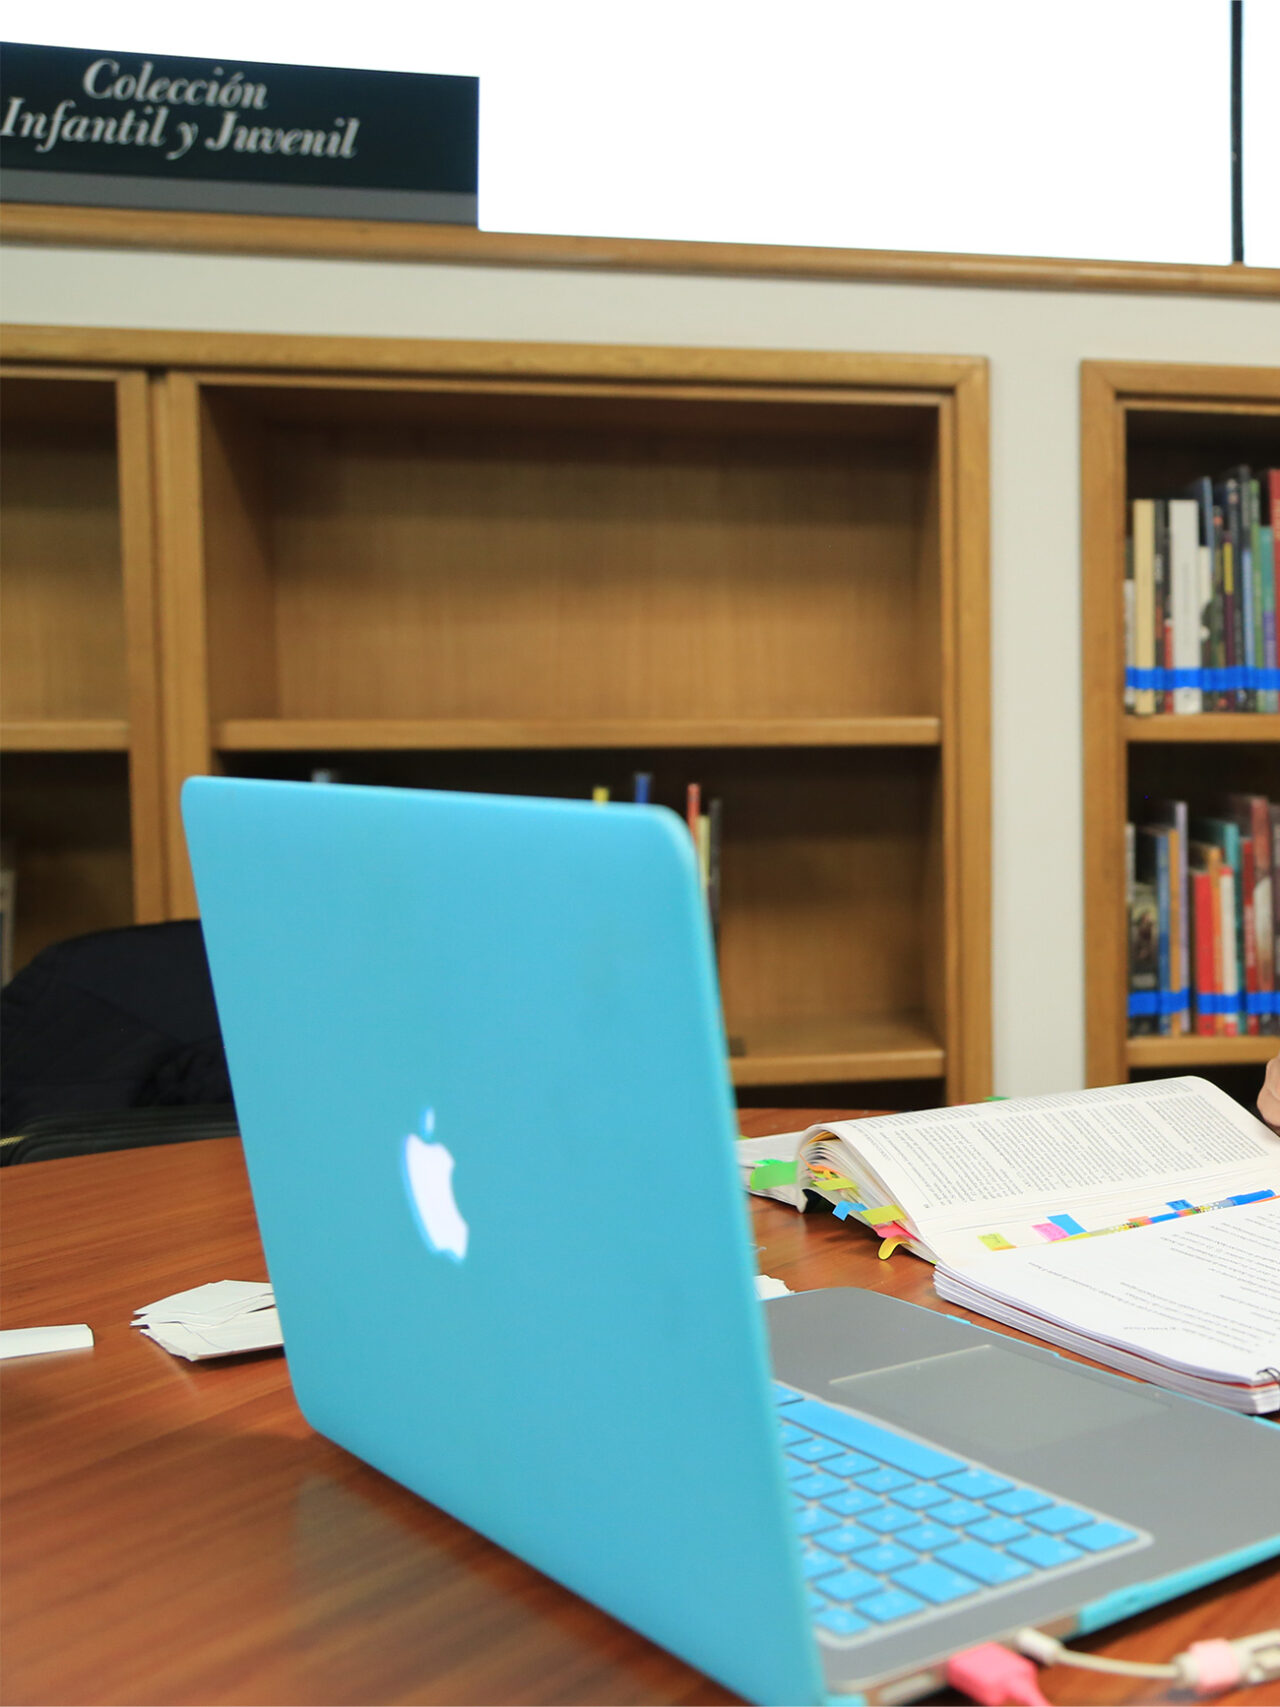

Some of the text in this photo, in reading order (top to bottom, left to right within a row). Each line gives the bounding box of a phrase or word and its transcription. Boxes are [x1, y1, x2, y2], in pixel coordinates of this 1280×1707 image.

[82, 58, 269, 110] Colección
[0, 97, 361, 161] Infantil y Juvenil
